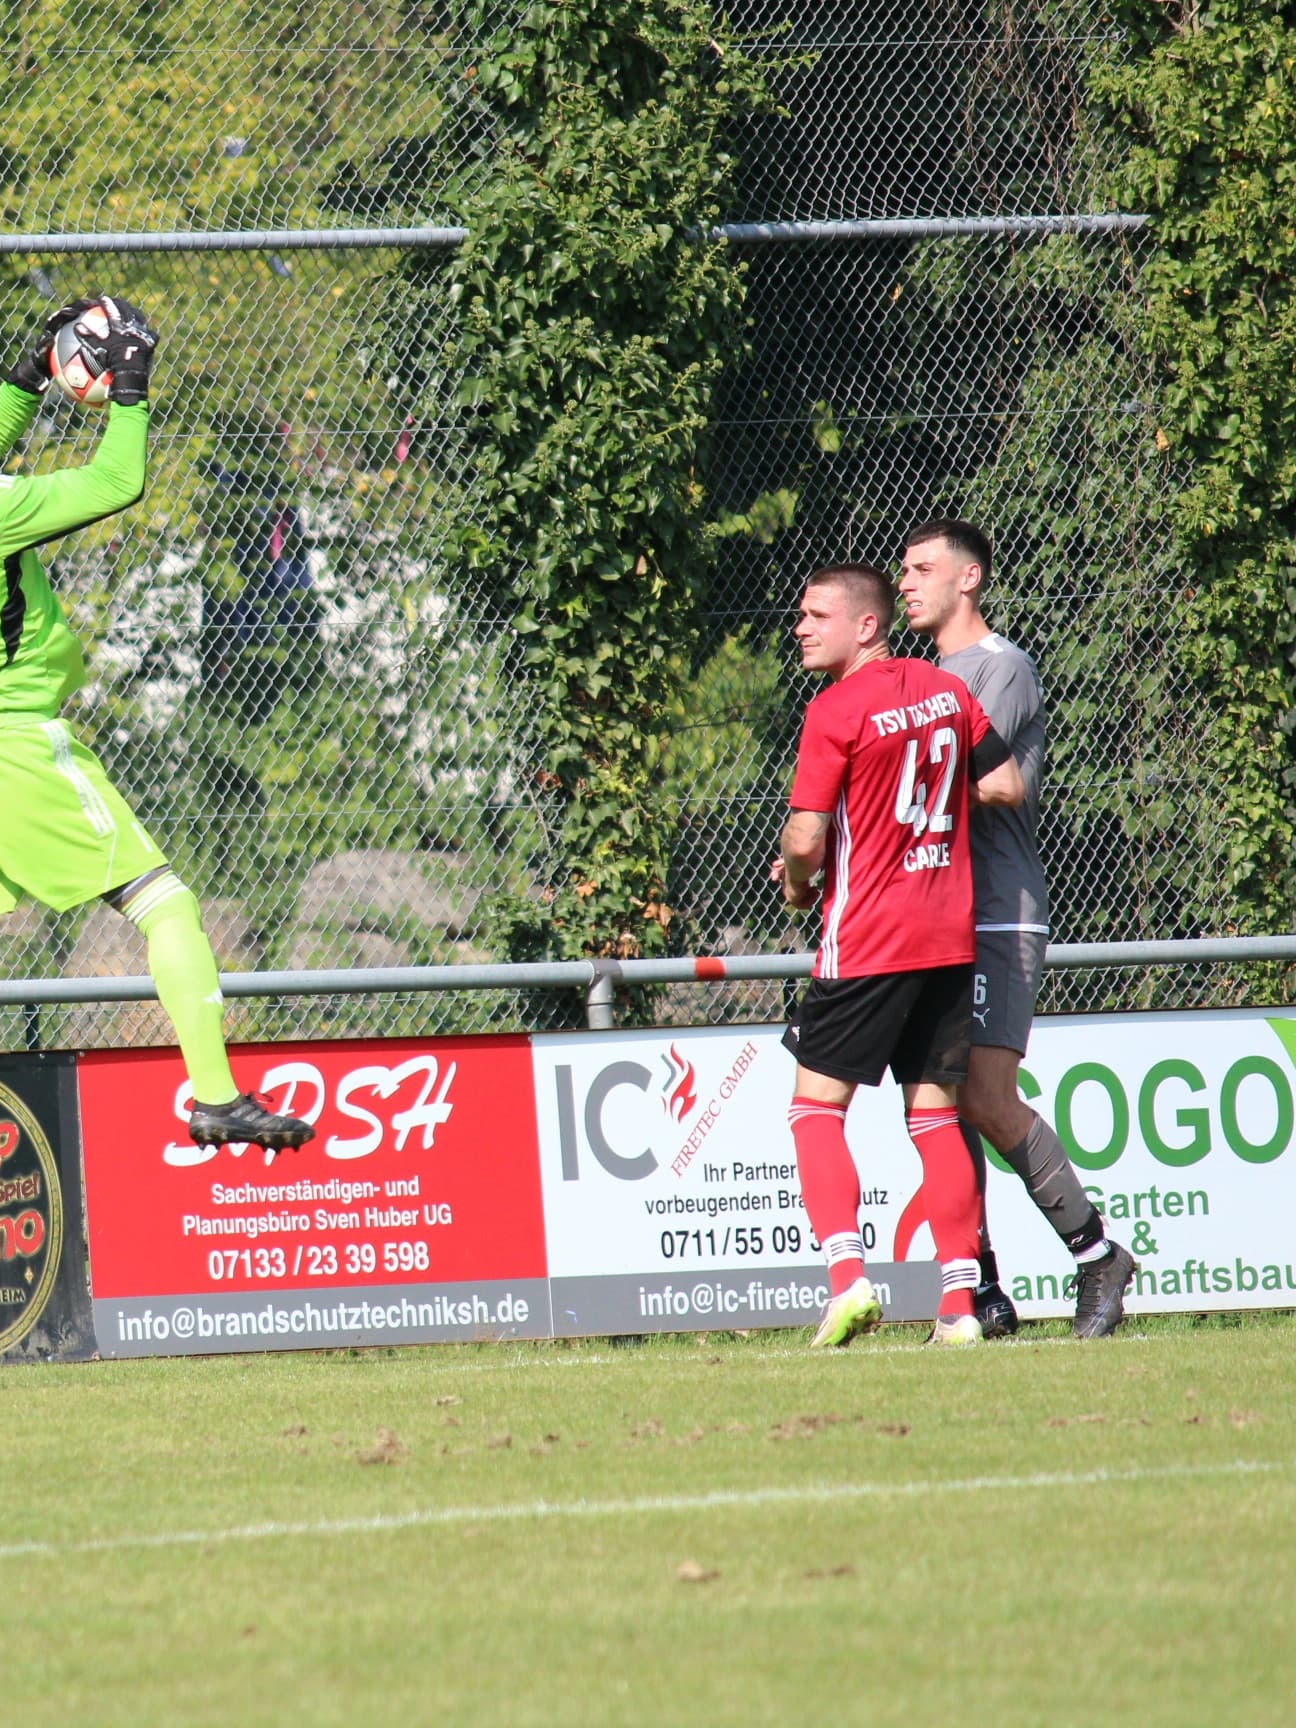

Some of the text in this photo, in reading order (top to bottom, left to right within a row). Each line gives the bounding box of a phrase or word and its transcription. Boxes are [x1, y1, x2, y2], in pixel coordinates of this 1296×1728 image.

[871, 691, 962, 737] TSV TALHEIM
[895, 727, 958, 838] 42
[554, 1060, 660, 1181] IC
[670, 1040, 759, 1179] FIRETEC GMBH
[211, 1175, 421, 1205] Sachverständigen- und
[703, 1162, 797, 1183] Ihr Partner
[183, 1203, 452, 1238] Planungsbüro Sven Huber UG
[645, 1192, 772, 1218] vorbeugenden
[772, 1225, 802, 1253] 09
[1130, 1220, 1159, 1256] &
[208, 1248, 286, 1281] 07133
[308, 1245, 338, 1275] 23
[345, 1243, 377, 1274] 39
[384, 1241, 430, 1272] 598
[117, 1293, 530, 1341] info@brandschutztechniksh.de
